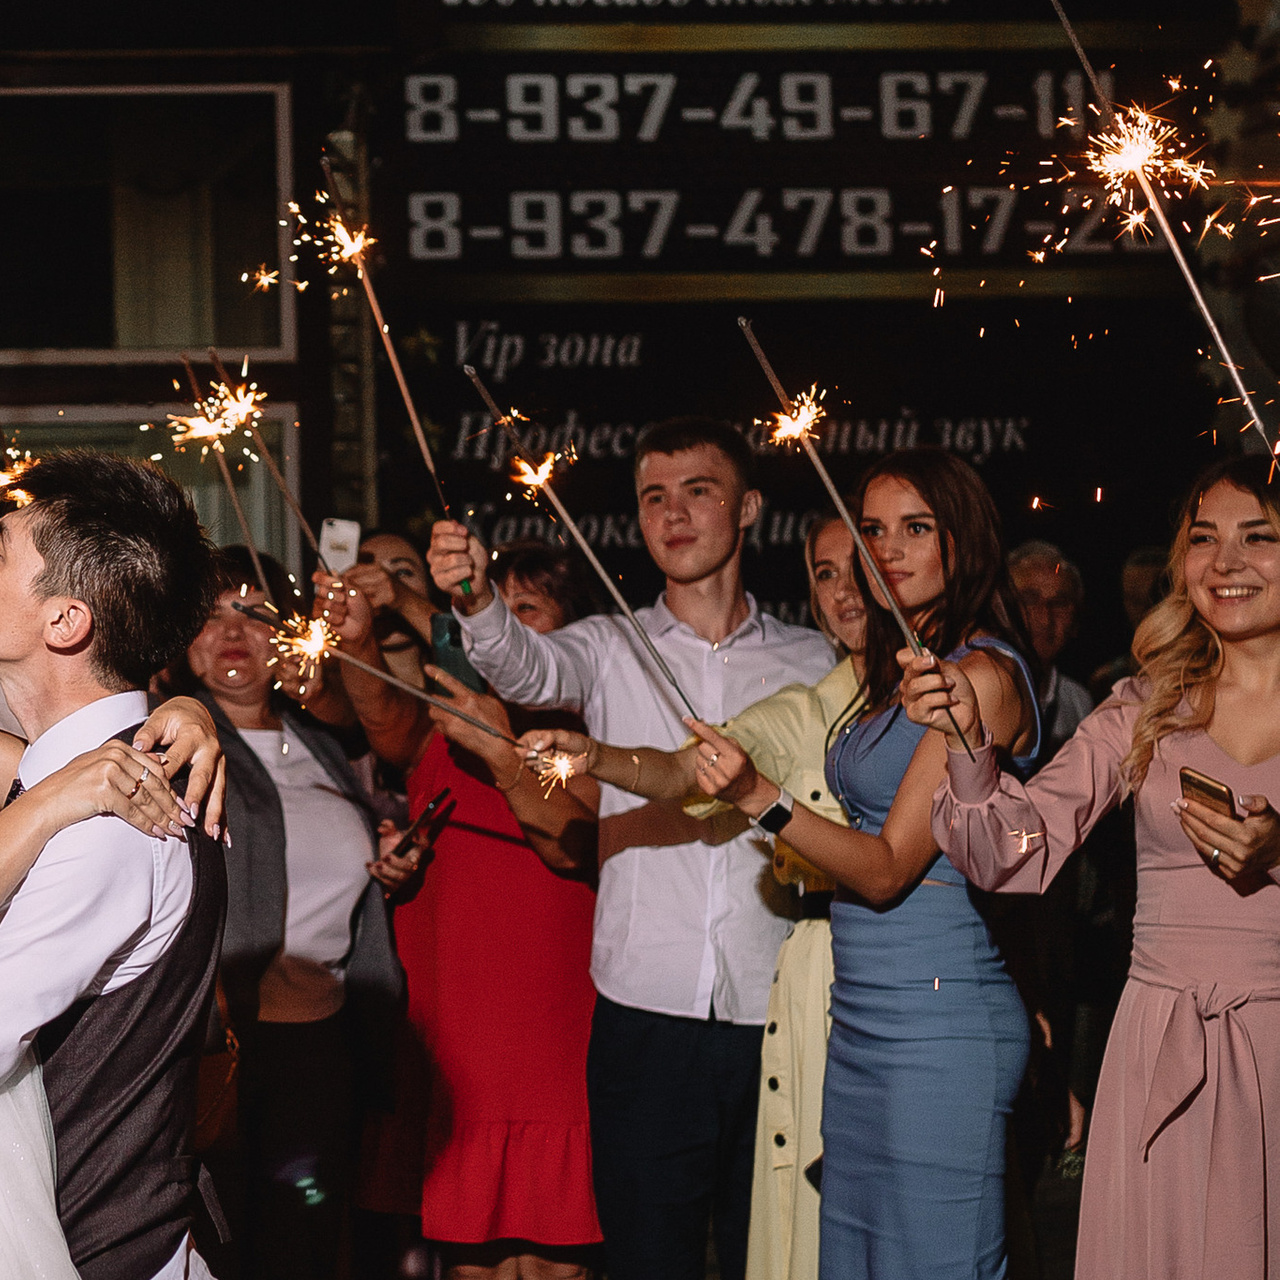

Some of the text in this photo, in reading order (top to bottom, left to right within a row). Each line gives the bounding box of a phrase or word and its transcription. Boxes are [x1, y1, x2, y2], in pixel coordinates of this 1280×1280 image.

[454, 320, 644, 383] Vip зона
[934, 415, 1031, 466] звук
